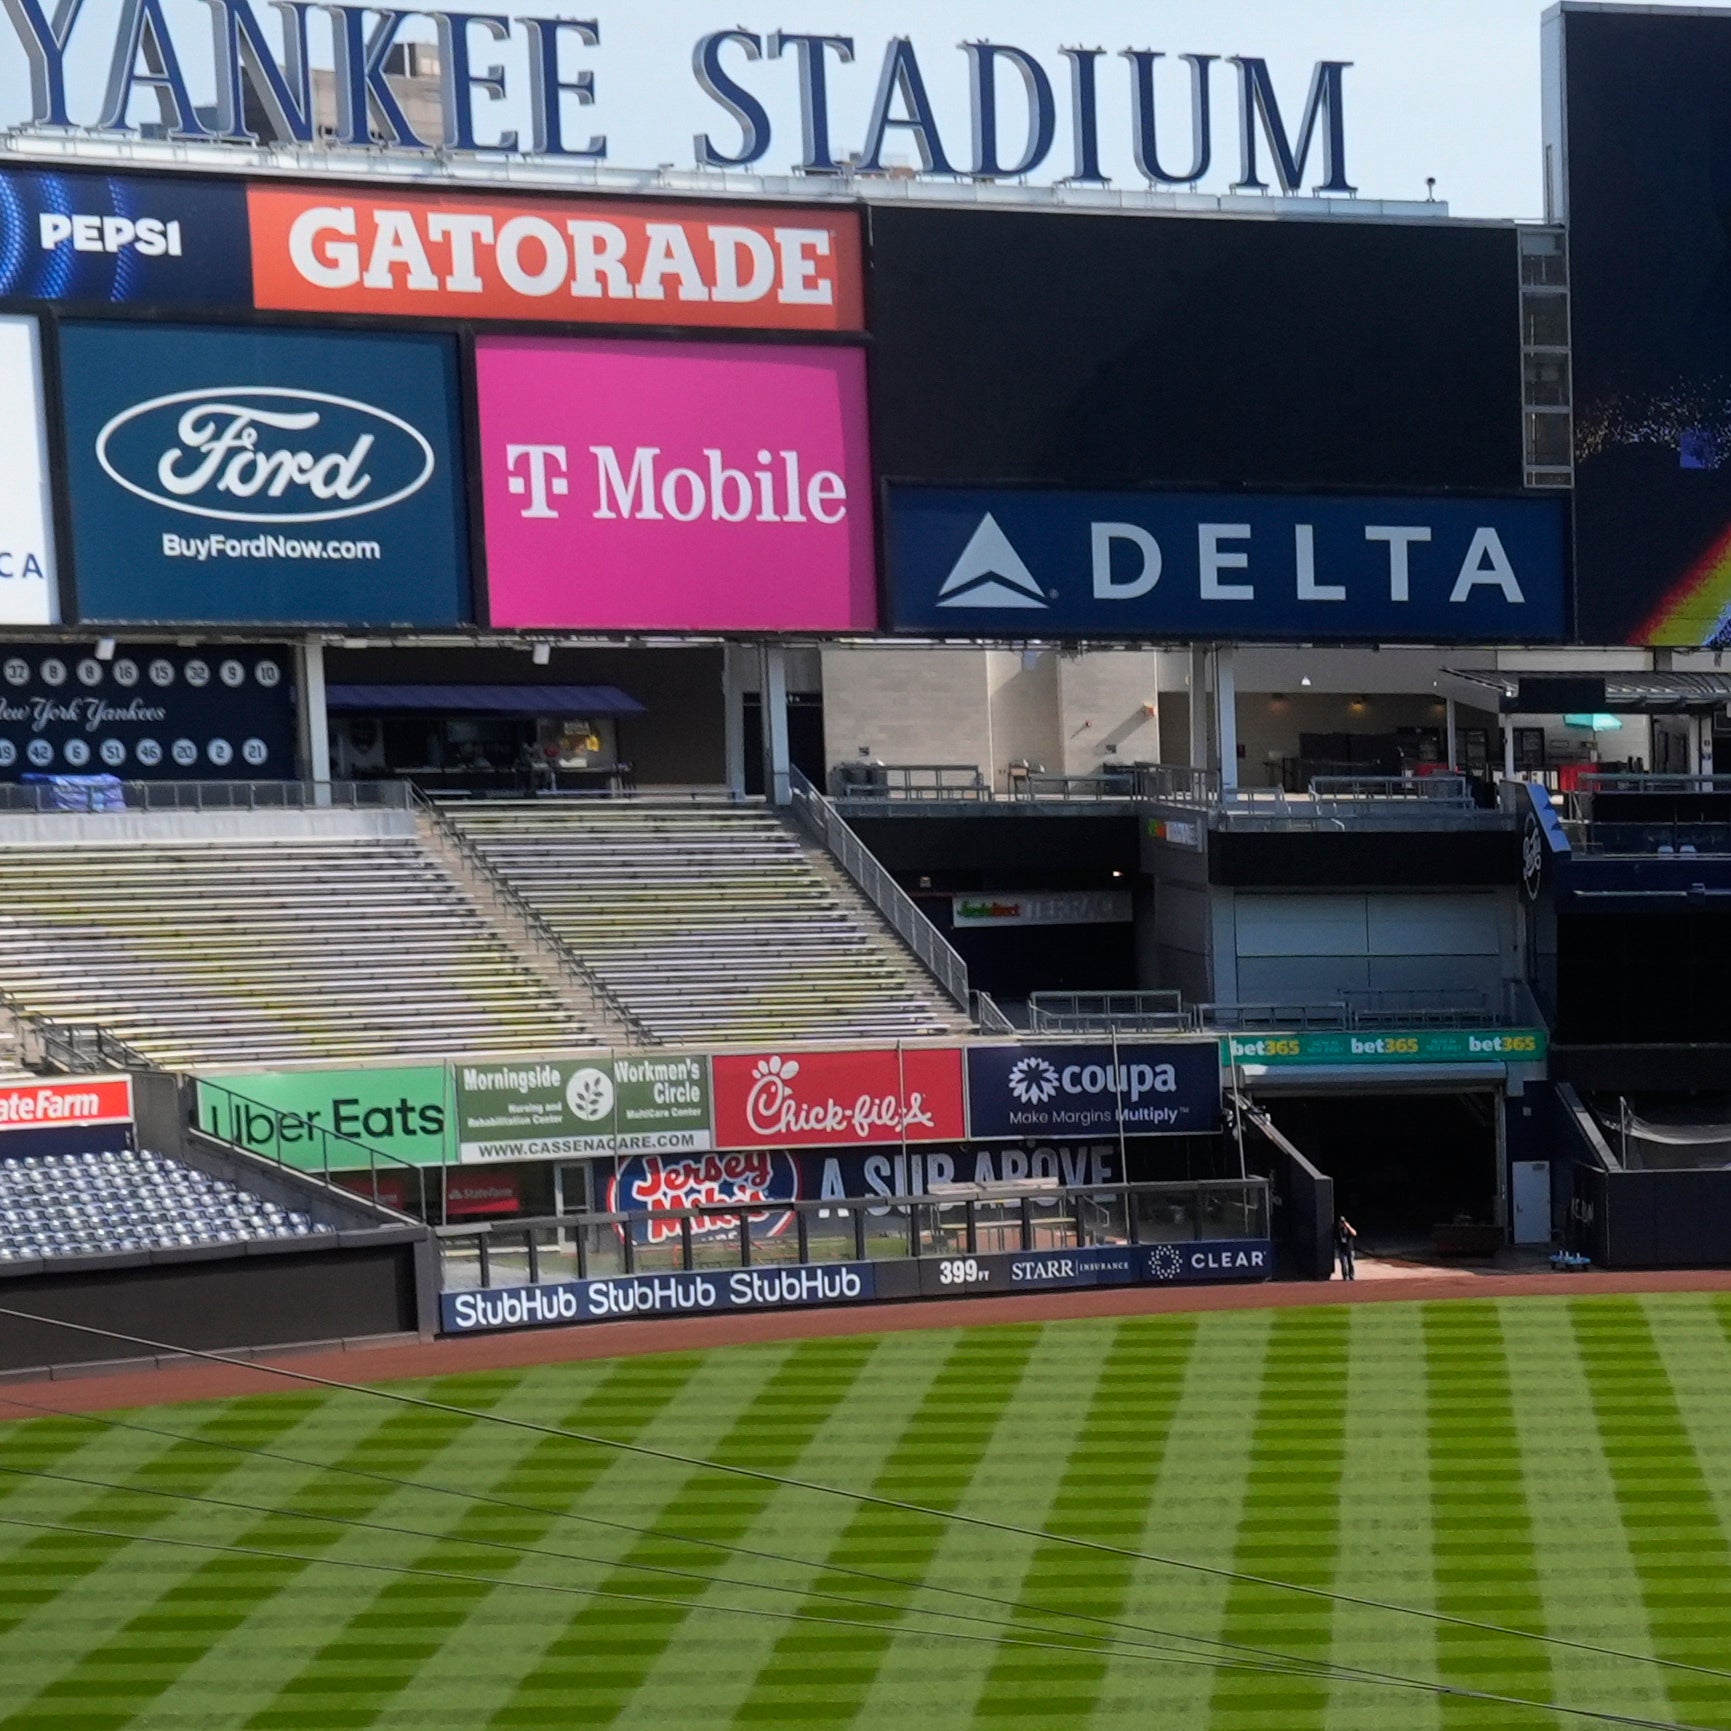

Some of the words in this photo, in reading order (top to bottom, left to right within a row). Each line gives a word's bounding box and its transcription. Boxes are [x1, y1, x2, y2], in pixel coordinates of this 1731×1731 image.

[0, 0, 606, 158] YANKEE
[692, 26, 1357, 194] STADIUM
[40, 213, 182, 257] PEPSI
[288, 206, 834, 305] GATORADE
[156, 402, 374, 501] Ford
[594, 446, 847, 525] Mobile
[162, 534, 381, 562] BuyFordNow.com
[1090, 521, 1526, 604] DELTA
[1231, 1039, 1300, 1056] bet365
[1351, 1037, 1419, 1054] bet365
[1469, 1036, 1536, 1052] bet365
[463, 1066, 561, 1093] Morningside
[614, 1058, 700, 1084] Workmen's
[1061, 1062, 1177, 1102] coupa
[654, 1082, 700, 1104] Circle
[211, 1104, 320, 1145] Uber
[332, 1098, 444, 1138] Eats
[1010, 1109, 1048, 1125] Make
[1052, 1108, 1111, 1127] Margins
[478, 1134, 695, 1158] WWW.CASSENACARE.COM
[632, 1152, 772, 1200] Jersey
[818, 1157, 849, 1218] A
[1012, 1259, 1074, 1281] STARR
[1080, 1261, 1129, 1272] INSURANCE
[1191, 1251, 1265, 1269] CLEAR
[455, 1292, 577, 1328] StubHub
[588, 1276, 716, 1315] StubHub
[730, 1265, 861, 1305] StubHub
